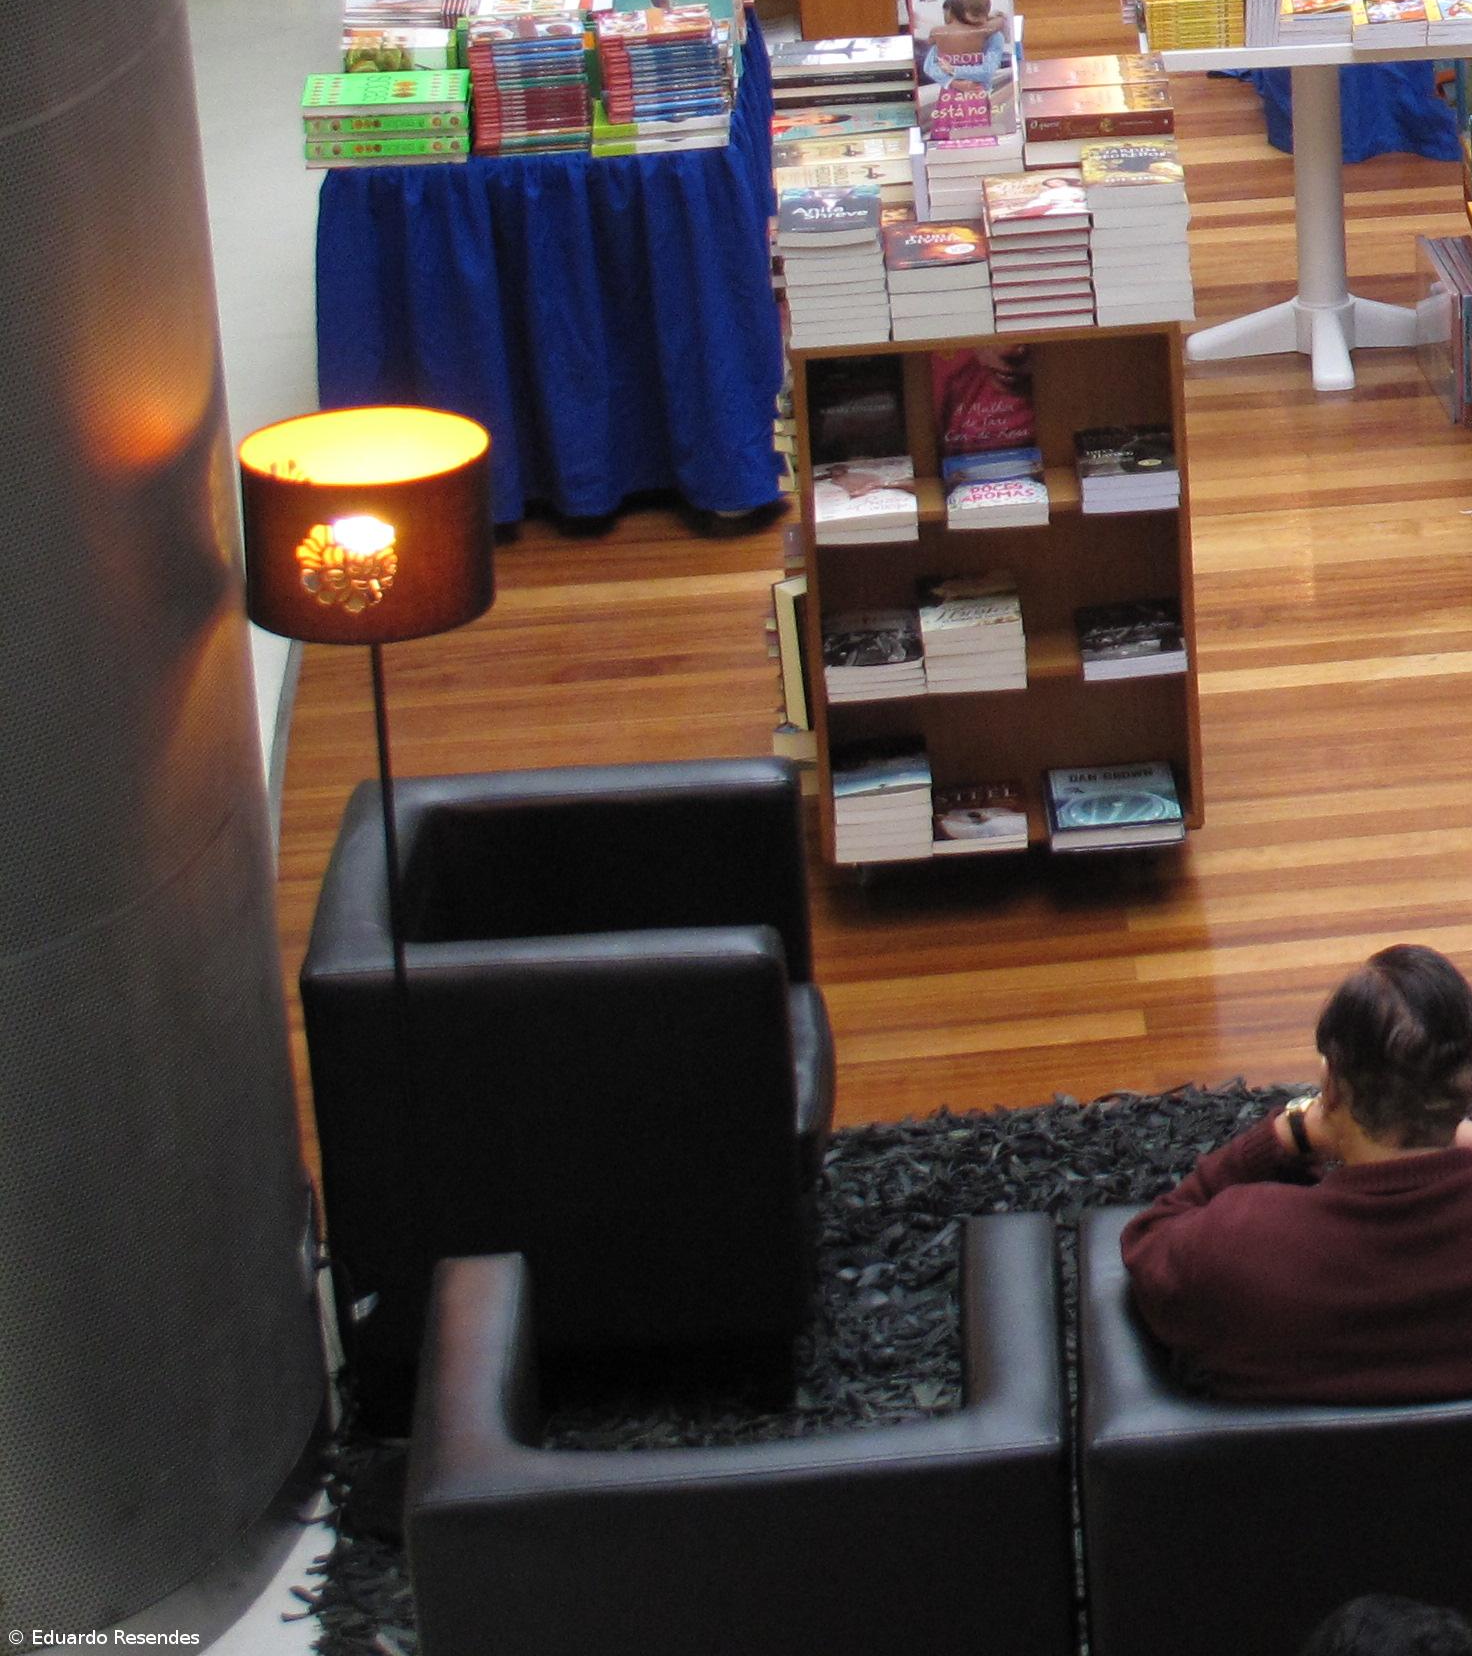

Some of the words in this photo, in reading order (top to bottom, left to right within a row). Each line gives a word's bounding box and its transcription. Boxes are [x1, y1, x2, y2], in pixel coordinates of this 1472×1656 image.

[954, 90, 993, 102] amor
[931, 106, 964, 119] está
[968, 105, 986, 115] no
[991, 103, 1006, 113] ar
[792, 206, 843, 216] Anita
[961, 489, 1035, 502] AROMAS
[1068, 772, 1098, 783] DAN
[1103, 770, 1153, 781] BROWN
